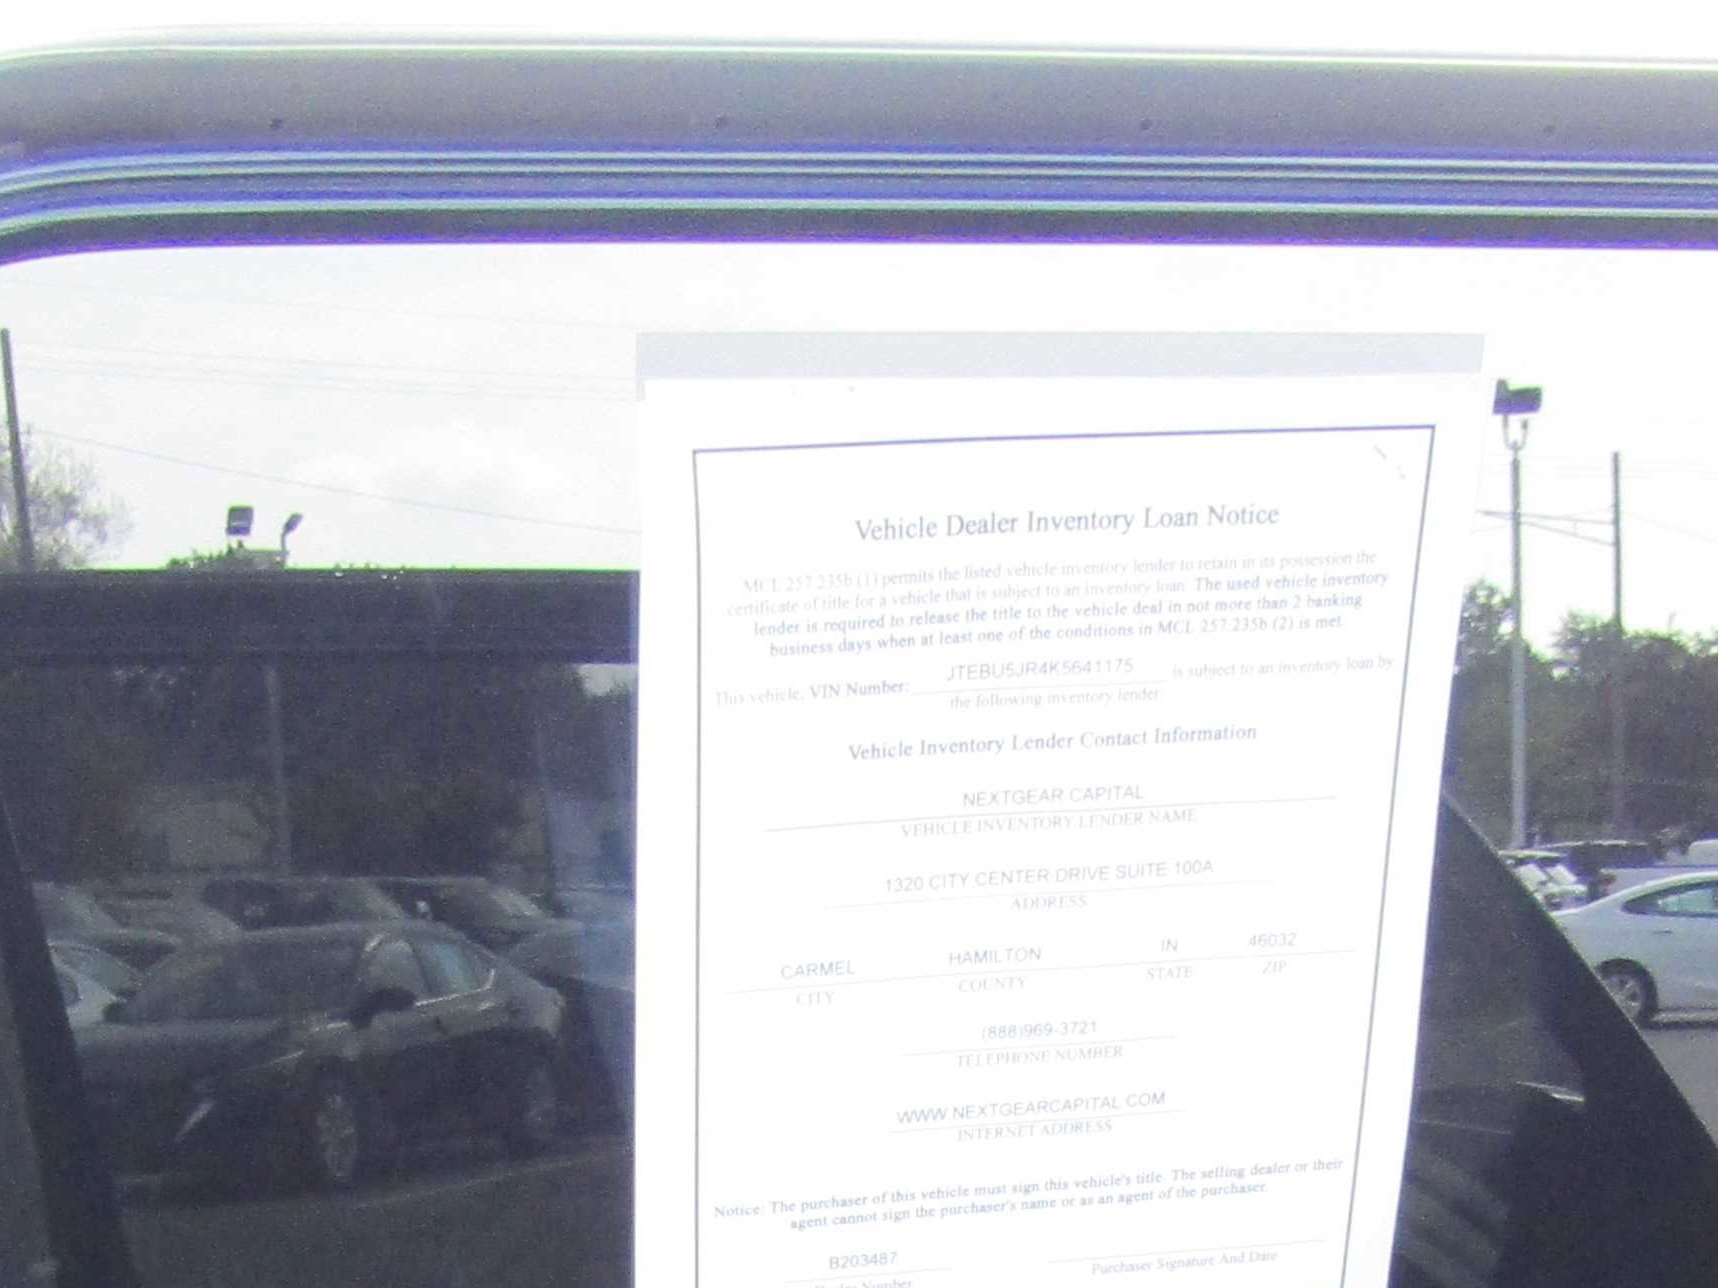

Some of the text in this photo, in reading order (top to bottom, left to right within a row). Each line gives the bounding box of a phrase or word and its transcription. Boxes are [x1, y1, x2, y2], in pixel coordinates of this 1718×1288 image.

[855, 503, 1279, 541] Vehicle Dealer Inventory Loan Notice
[821, 594, 850, 611] title
[854, 593, 876, 611] for
[891, 588, 941, 606] vehicle
[945, 587, 972, 603] that
[991, 584, 1041, 606] subject
[1063, 585, 1081, 597] an
[1084, 581, 1152, 598] inventory
[1194, 576, 1222, 592] The
[1226, 575, 1261, 592] used
[1265, 574, 1318, 590] vehicle
[1322, 572, 1388, 587] inventory
[754, 592, 1363, 635] lender is required to release the title to the vehicle deal in not more than 2 banking
[769, 641, 834, 657] business
[837, 633, 872, 655] days
[877, 633, 916, 649] when
[920, 633, 934, 647] at
[939, 631, 973, 645] least
[977, 631, 1004, 642] one
[1008, 625, 1027, 641] of
[1029, 624, 1052, 640] the
[1056, 623, 1134, 640] conditions
[1138, 623, 1154, 636] in
[1157, 619, 1194, 635] MCL
[1271, 615, 1295, 632] (2)
[1298, 616, 1311, 630] is
[809, 683, 841, 700] VIN
[846, 680, 910, 696] Number:
[1188, 663, 1236, 680] subject
[1278, 660, 1342, 675] inventory
[1346, 656, 1375, 671] loan
[1377, 653, 1395, 672] by
[949, 695, 972, 710] the
[975, 692, 1043, 709] following
[1047, 691, 1114, 706] inventory
[848, 725, 1257, 760] Vehicle Inventory Lender Contact Information
[963, 784, 1144, 807] NEXTGEAR CAPITAL
[900, 808, 1196, 838] VEHICLE INVENTORY LENDER NAME
[885, 859, 1214, 893] 1320 CITY CENTER DRIVE SUITE 100A
[1011, 894, 1087, 910] ADDRESS
[948, 947, 1042, 965] HAMILTON
[1161, 938, 1179, 952] IN
[780, 960, 855, 980] CARMEL
[1146, 965, 1193, 981] STATE
[1262, 959, 1288, 976] ZIP
[958, 976, 1027, 993] COUNTY
[795, 991, 835, 1006] CITY
[982, 1020, 1096, 1040] (888)969-3721
[958, 1045, 1123, 1068] TELEPHONE NUMBER
[957, 1118, 1112, 1142] INTERNET ADDRESS
[714, 1205, 766, 1218] Notice:
[769, 1200, 797, 1214] The
[800, 1196, 868, 1214] purchaser
[871, 1190, 889, 1205] of
[890, 1189, 916, 1203] this
[920, 1185, 970, 1200] vehicle
[973, 1184, 1007, 1197] must
[1011, 1183, 1040, 1197] sign
[1044, 1178, 1069, 1192] this
[1172, 1168, 1197, 1182] The
[1200, 1165, 1246, 1180] selling
[1249, 1162, 1291, 1176] dealer
[1293, 1162, 1309, 1173] or
[1312, 1158, 1344, 1171] their
[790, 1213, 828, 1232] agent
[832, 1212, 877, 1226] cannot
[882, 1209, 911, 1224] sign
[915, 1205, 936, 1219] the
[1020, 1199, 1057, 1211] name
[1060, 1197, 1076, 1208] or
[1079, 1196, 1095, 1207] as
[1097, 1194, 1115, 1205] an
[1117, 1190, 1154, 1206] agent
[1157, 1186, 1175, 1200] of
[1175, 1185, 1197, 1199] the
[828, 1251, 898, 1270] B203487
[1091, 1249, 1278, 1275] Purchaser Signature And Date
